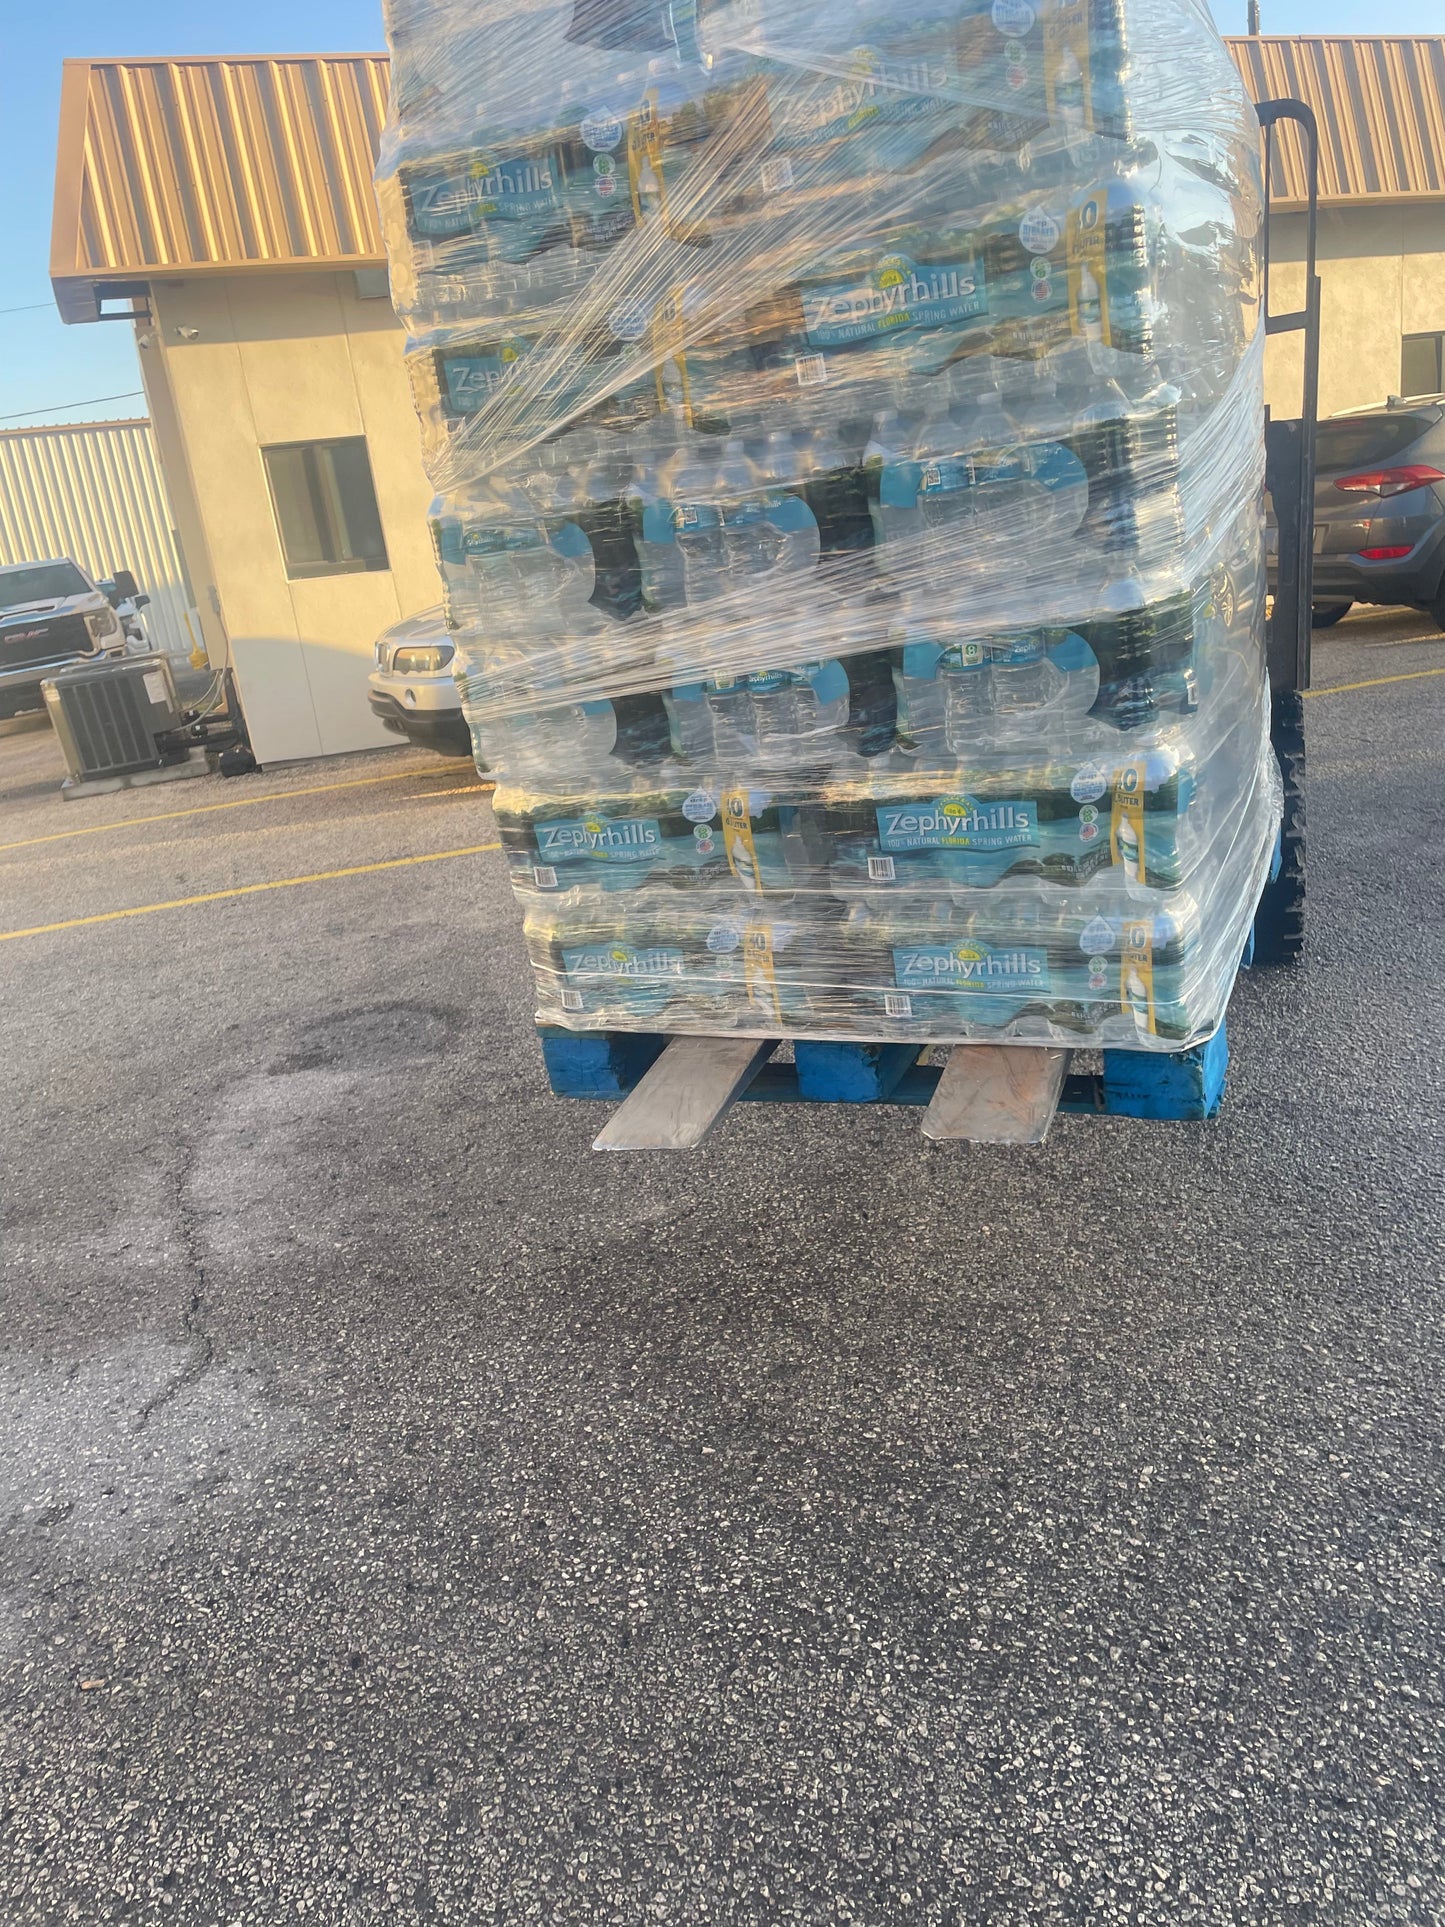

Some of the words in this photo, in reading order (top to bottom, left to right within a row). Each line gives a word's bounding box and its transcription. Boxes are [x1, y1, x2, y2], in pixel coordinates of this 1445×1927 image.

[421, 166, 553, 214] Zephyrhills
[806, 270, 977, 331] Zephyrhills
[838, 324, 876, 339] NATURAL
[877, 311, 911, 329] FLORIDA
[912, 309, 947, 323] SPRING
[949, 301, 980, 316] WATER
[544, 823, 656, 849] Zephyrhills
[885, 806, 1030, 836] Zephyrhills
[906, 836, 940, 846] NATURAL
[941, 836, 970, 846] FLORIDA
[972, 836, 1003, 846] SPRING
[1005, 834, 1032, 844] WATER
[902, 951, 1041, 979] Zephyrhills
